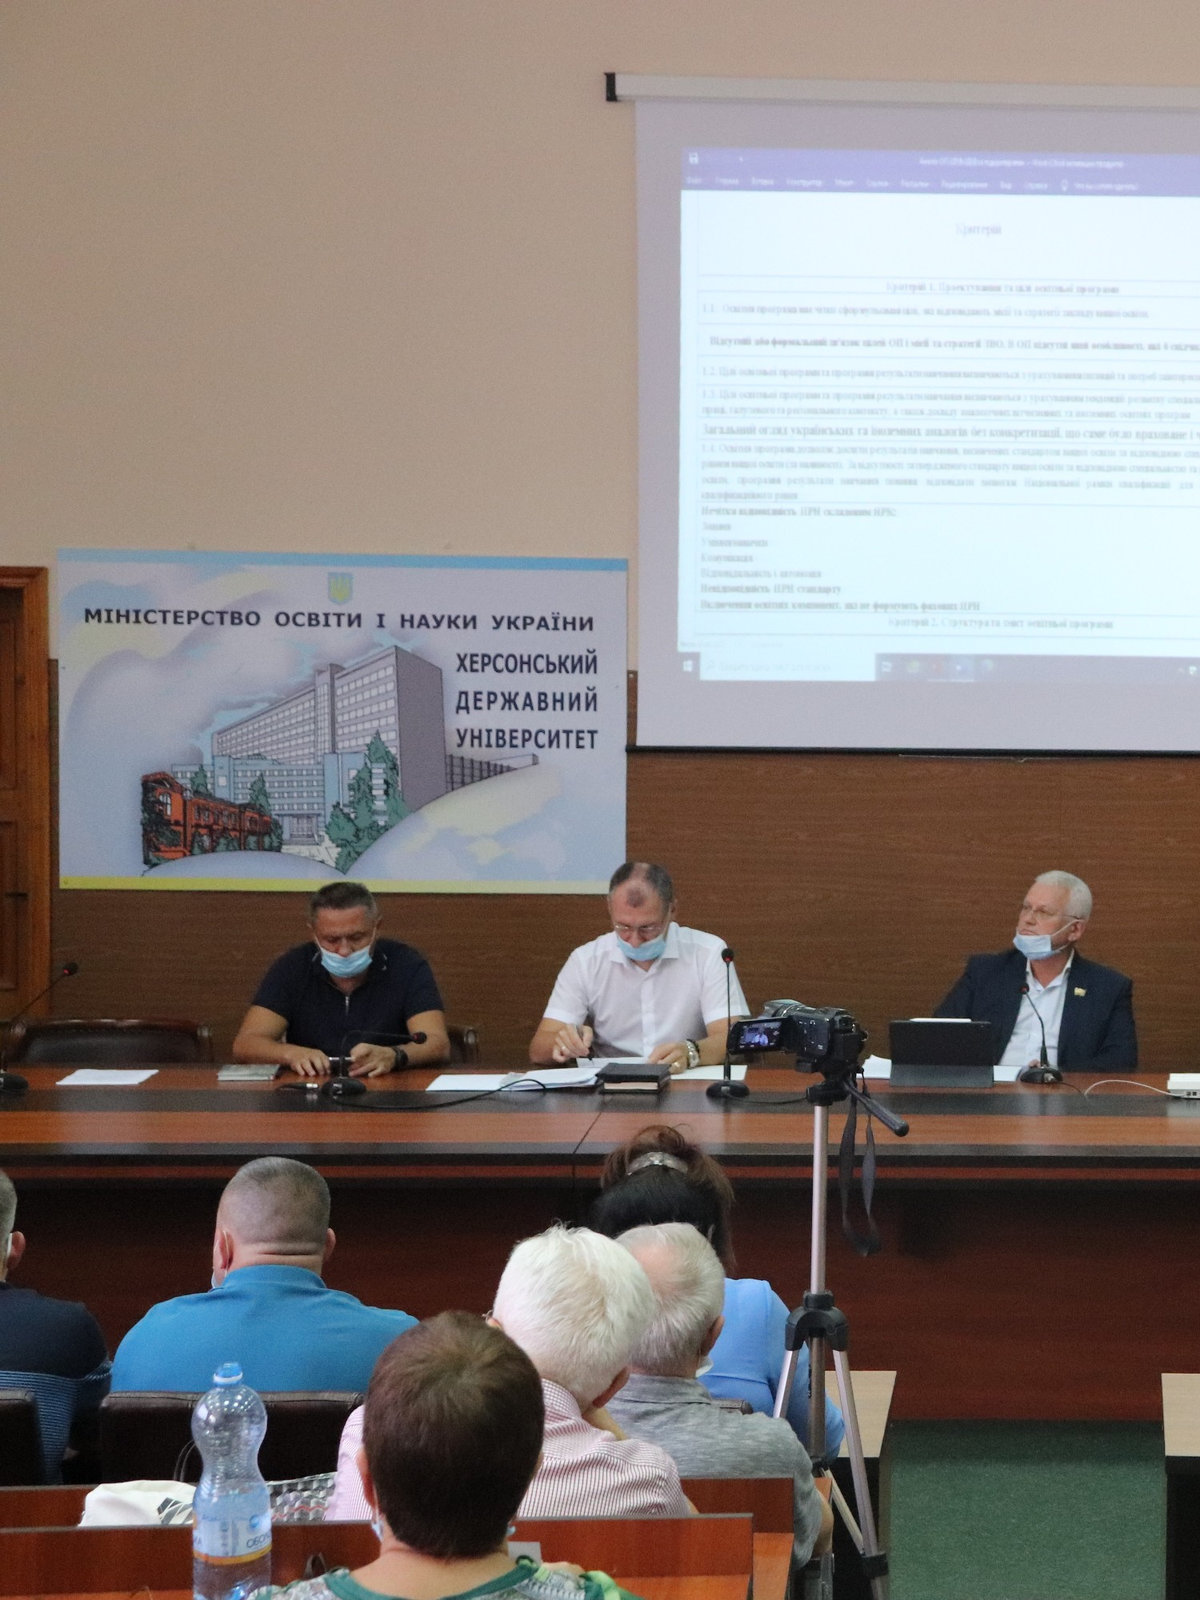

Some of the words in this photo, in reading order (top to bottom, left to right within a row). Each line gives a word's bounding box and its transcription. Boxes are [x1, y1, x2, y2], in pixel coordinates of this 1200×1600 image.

[84, 607, 261, 627] МІНІСТЕРСТВО
[275, 611, 362, 628] ОСВІТИ
[376, 613, 386, 629] І
[400, 614, 478, 630] НАУКИ
[492, 612, 594, 632] УКРАЇНИ
[456, 649, 598, 675] ХЕРСОНСЬКИЙ
[456, 686, 598, 714] ДЕРЖАВНИЙ
[456, 728, 598, 750] УНІВЕРСИТЕТ
